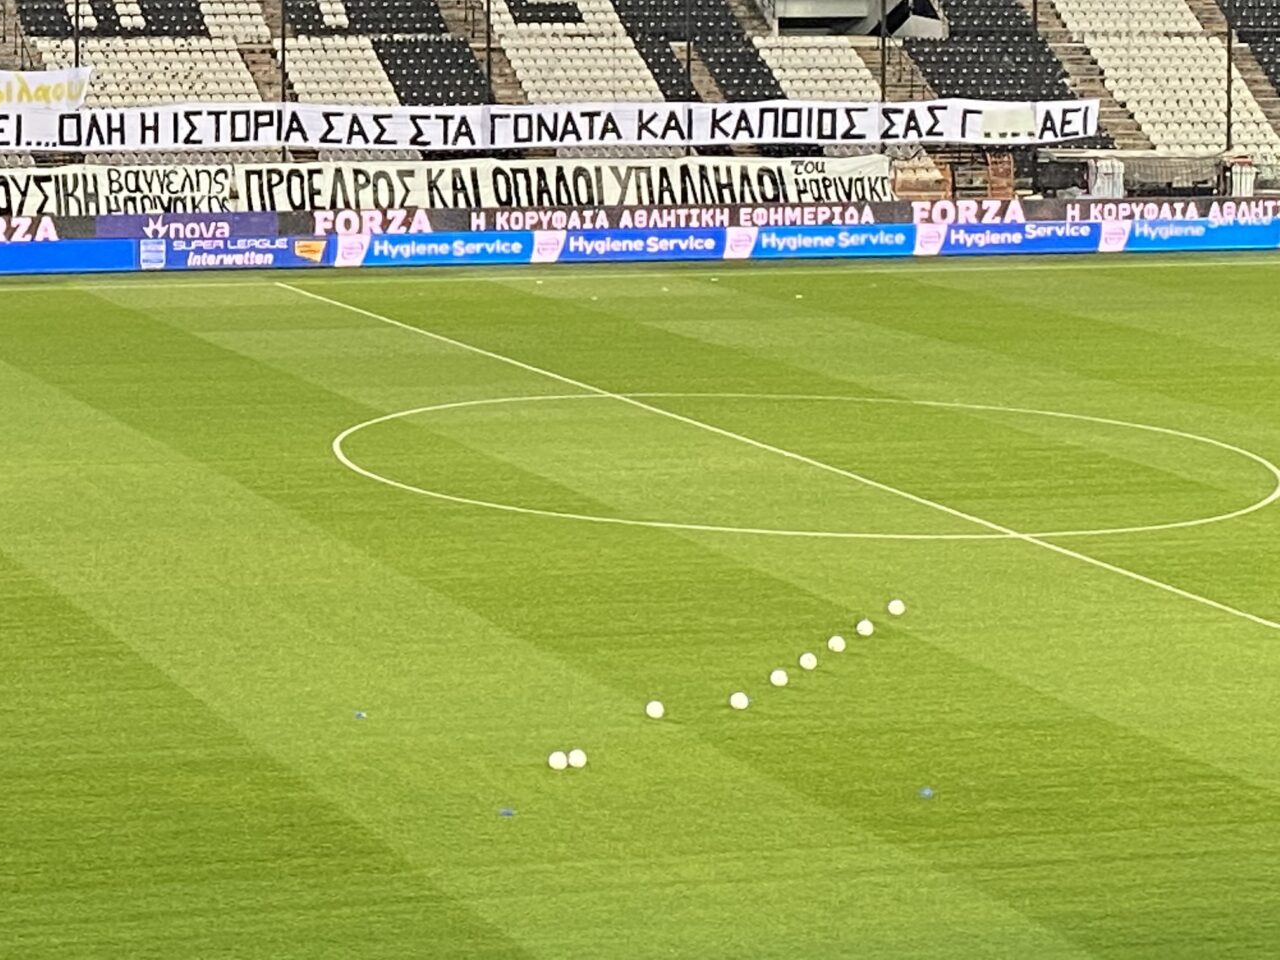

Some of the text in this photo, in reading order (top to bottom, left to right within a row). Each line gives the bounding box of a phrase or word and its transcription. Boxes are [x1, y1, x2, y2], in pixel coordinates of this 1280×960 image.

[140, 112, 159, 145] Η
[173, 109, 309, 144] ΙΣΤΟΡΙΑ
[321, 111, 398, 145] ΣΑΣ
[409, 114, 476, 146] ΣΤΑ
[490, 110, 622, 145] ΓΟΝΑΤΑ
[637, 108, 693, 140] ΚΑΙ
[710, 107, 868, 140] ΚΑΠΟΙΟΣ
[880, 106, 948, 139] ΣΑΣ
[426, 166, 482, 209] ΚΑΙ
[313, 209, 433, 236] FORZA
[471, 212, 486, 231] Η
[619, 208, 730, 228] ΑΘΛΗΤΙΚΗ
[739, 206, 875, 227] ΕΦΗΜΕΡΙΔΑ
[910, 199, 1027, 224] FORZA
[169, 221, 230, 239] nova
[761, 233, 835, 251] Hygiene
[838, 230, 906, 247] Service
[950, 227, 1023, 248] Hygiene
[1025, 223, 1091, 240] Service
[1134, 221, 1206, 240] Hygiene
[373, 239, 449, 259] Hygiene
[452, 238, 524, 257] Service
[569, 235, 644, 254] Hygiene
[646, 234, 716, 252] Service
